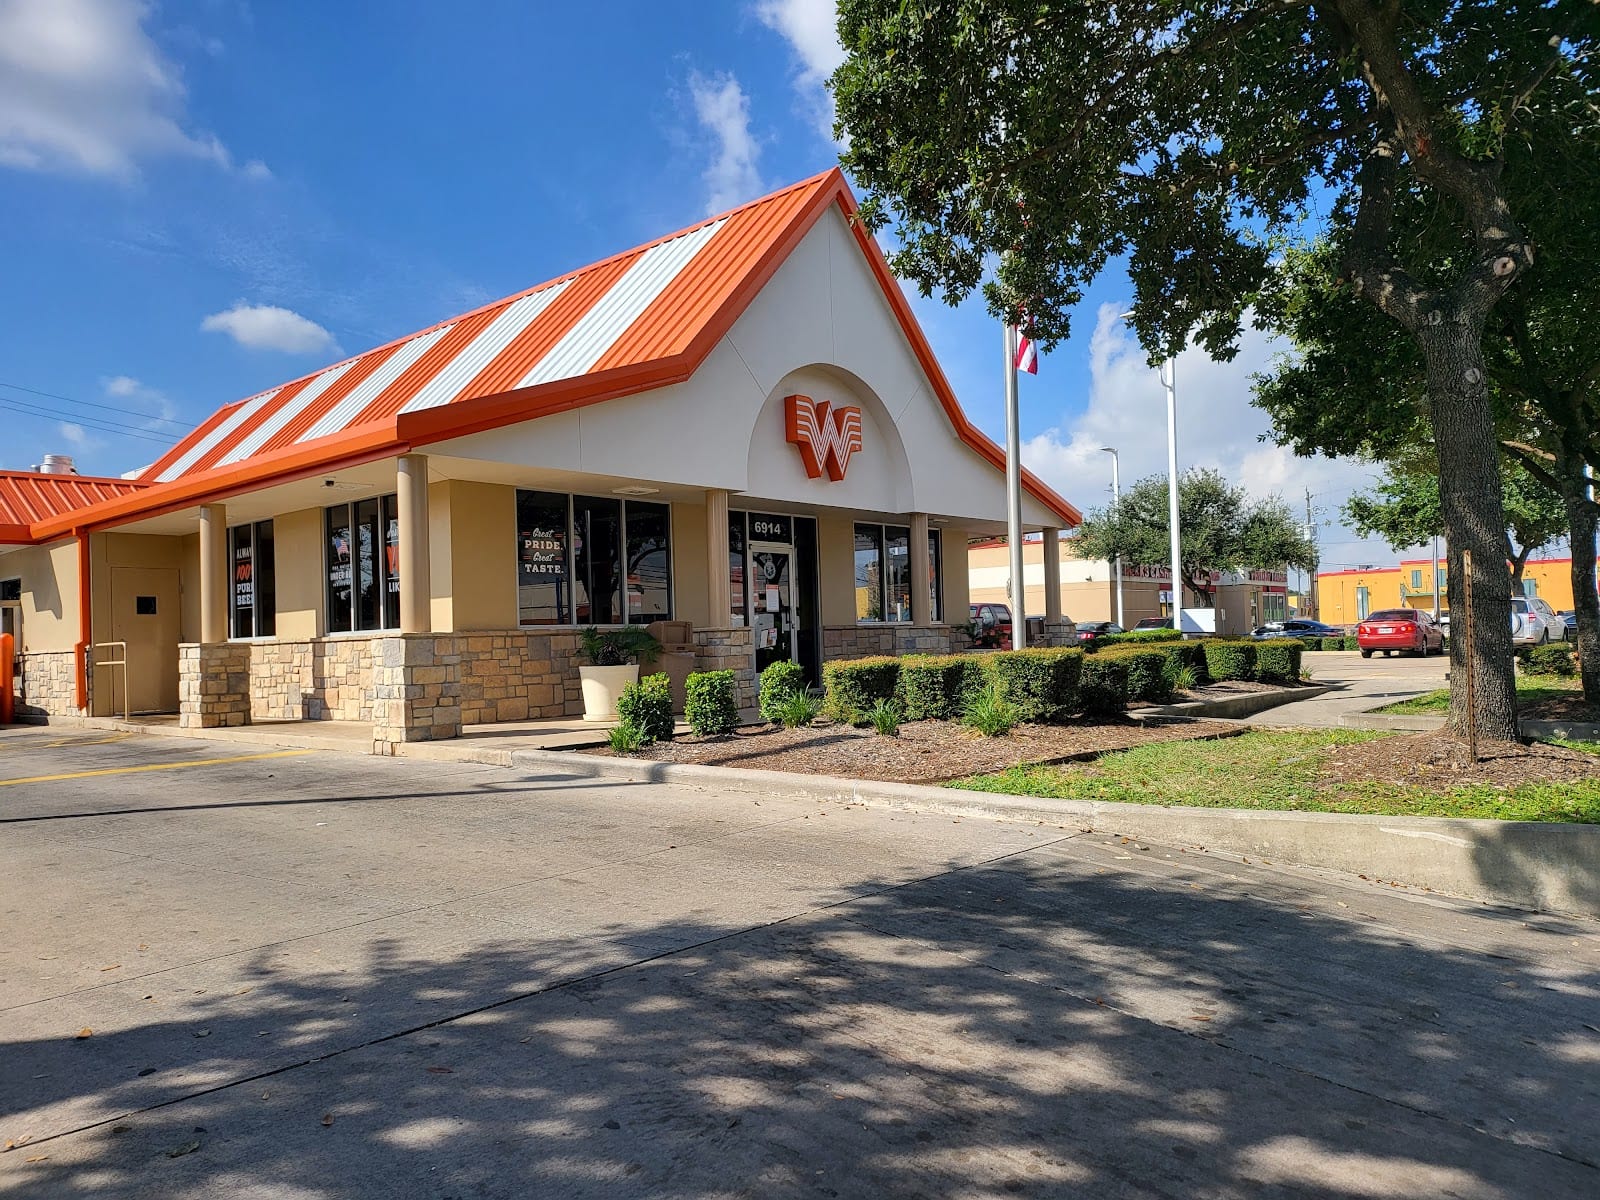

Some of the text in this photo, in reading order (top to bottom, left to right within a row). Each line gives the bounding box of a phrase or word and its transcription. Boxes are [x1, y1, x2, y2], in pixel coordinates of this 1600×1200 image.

[784, 394, 862, 482] W
[532, 527, 555, 538] Great
[754, 521, 781, 535] 6914
[524, 539, 564, 551] PRIDE.
[236, 546, 252, 560] ALWAY
[532, 551, 555, 562] Great
[236, 563, 253, 581] 100
[524, 563, 564, 574] TASTE.
[388, 581, 400, 593] LIK
